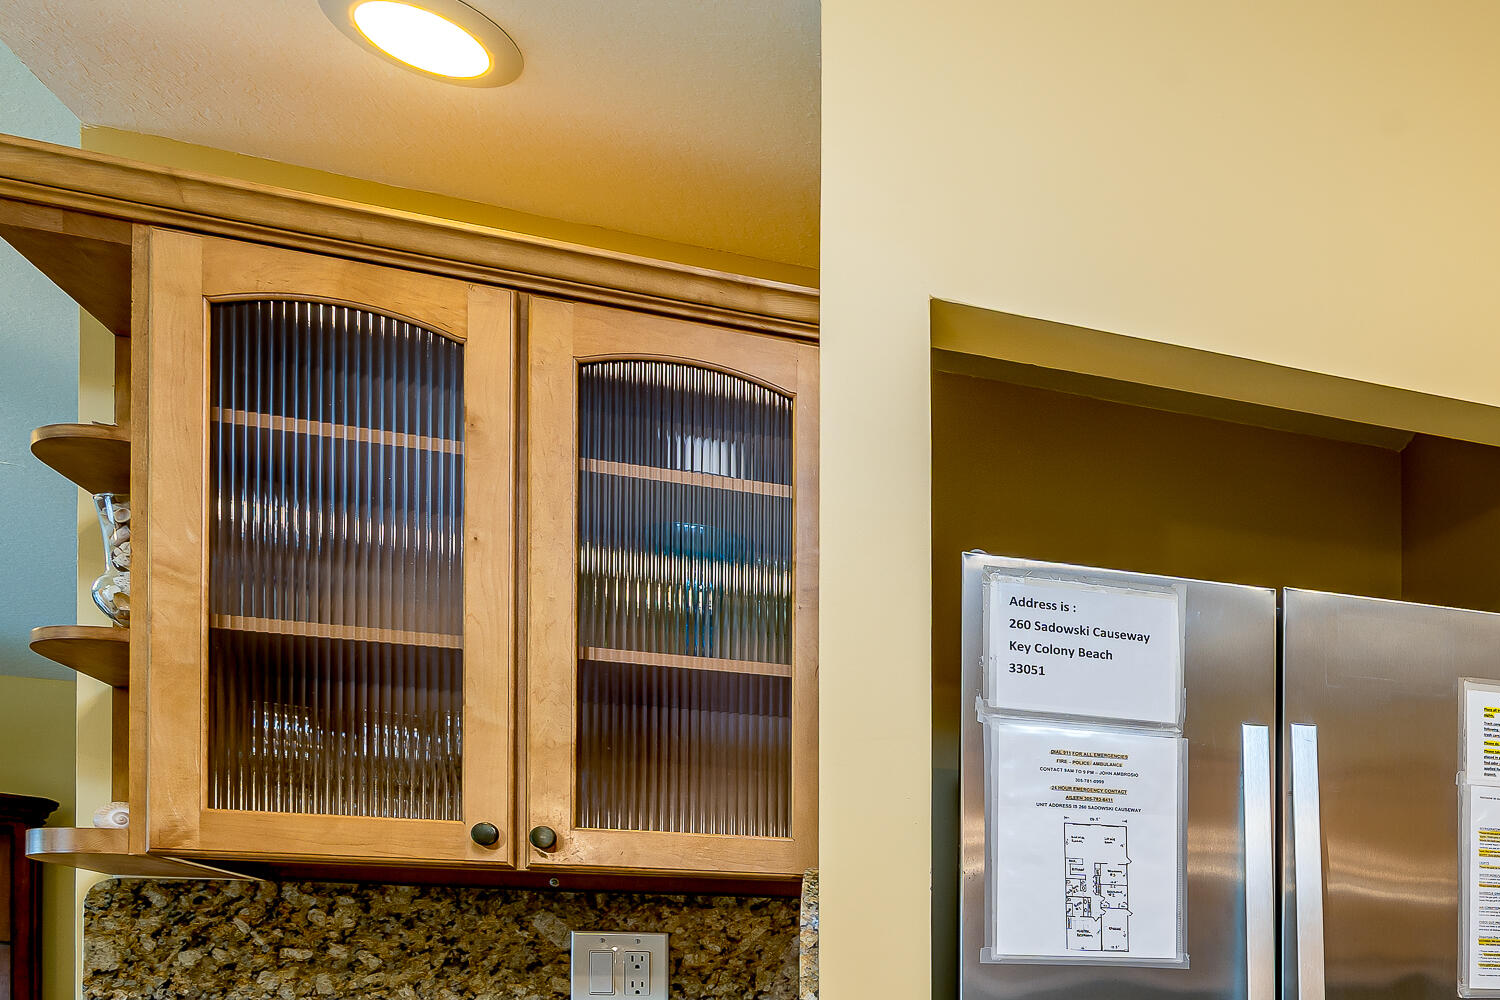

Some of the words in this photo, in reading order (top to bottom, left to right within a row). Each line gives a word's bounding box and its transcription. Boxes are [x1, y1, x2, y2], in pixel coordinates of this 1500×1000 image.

[1009, 596, 1057, 611] Address
[1060, 602, 1070, 612] is
[1009, 618, 1031, 630] 260
[1034, 621, 1090, 636] Sadowski
[1092, 627, 1150, 644] Causeway
[1009, 640, 1031, 654] Key
[1034, 643, 1075, 659] Colony
[1078, 647, 1113, 660] Beach
[1008, 663, 1046, 676] 33051
[1094, 752, 1128, 760] EMERGENCIES
